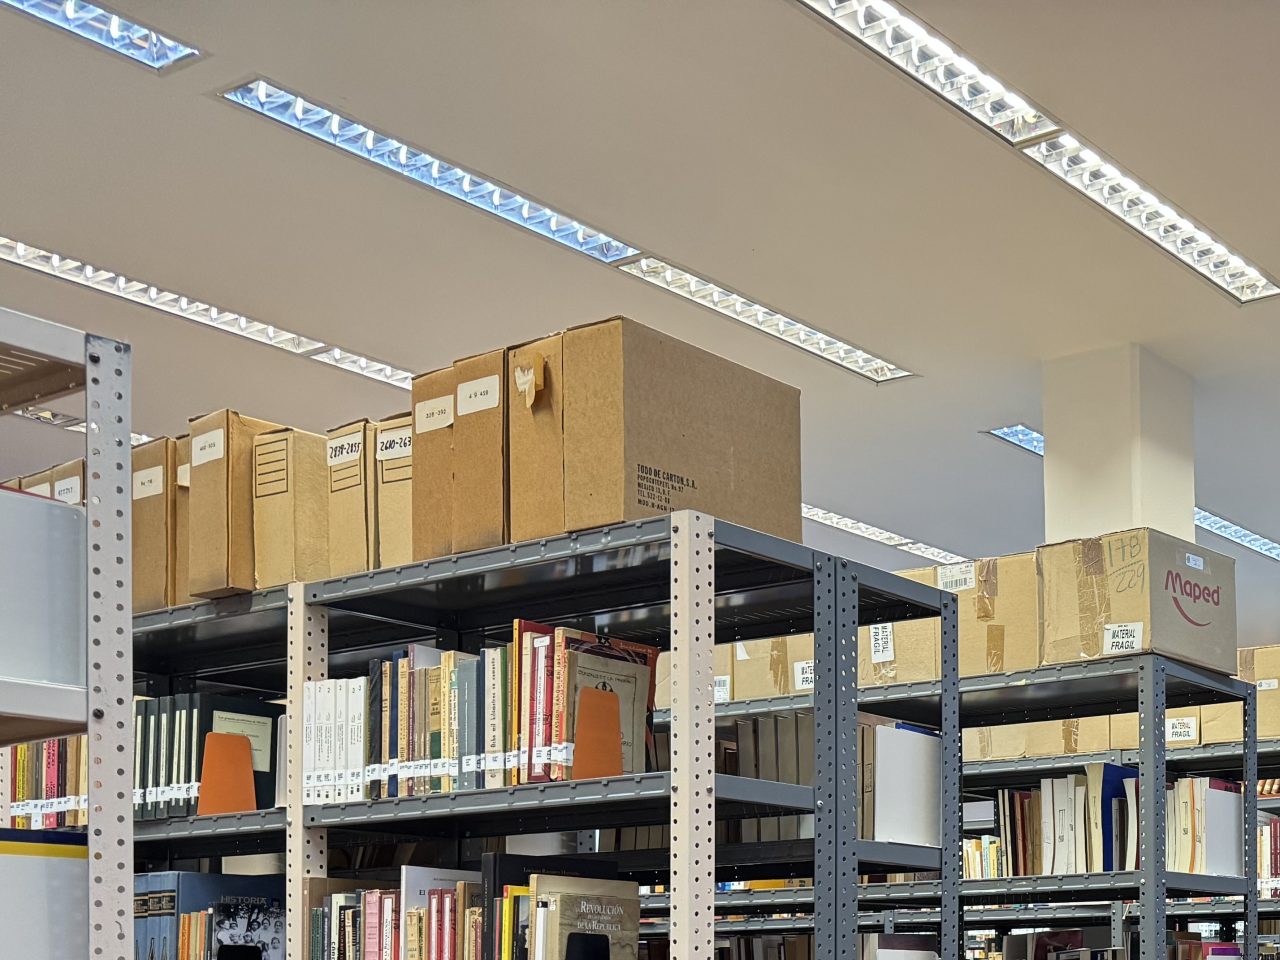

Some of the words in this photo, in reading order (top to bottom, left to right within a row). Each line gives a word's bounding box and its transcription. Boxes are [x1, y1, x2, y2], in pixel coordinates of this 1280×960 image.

[380, 436, 412, 452] 2610-263
[637, 464, 653, 476] TODO
[653, 469, 661, 479] DE
[637, 482, 655, 492] MEXICO
[1116, 562, 1145, 593] 229
[1164, 570, 1220, 607] Maped
[881, 625, 890, 654] MATERIAL
[1112, 629, 1136, 639] MATERIAL
[872, 626, 881, 655] FRAGIL
[1111, 640, 1135, 651] FRAGIL
[801, 666, 814, 675] MATE
[801, 676, 814, 685] FRA
[1171, 722, 1191, 730] MATERIAL
[1171, 730, 1192, 739] FRAGIL
